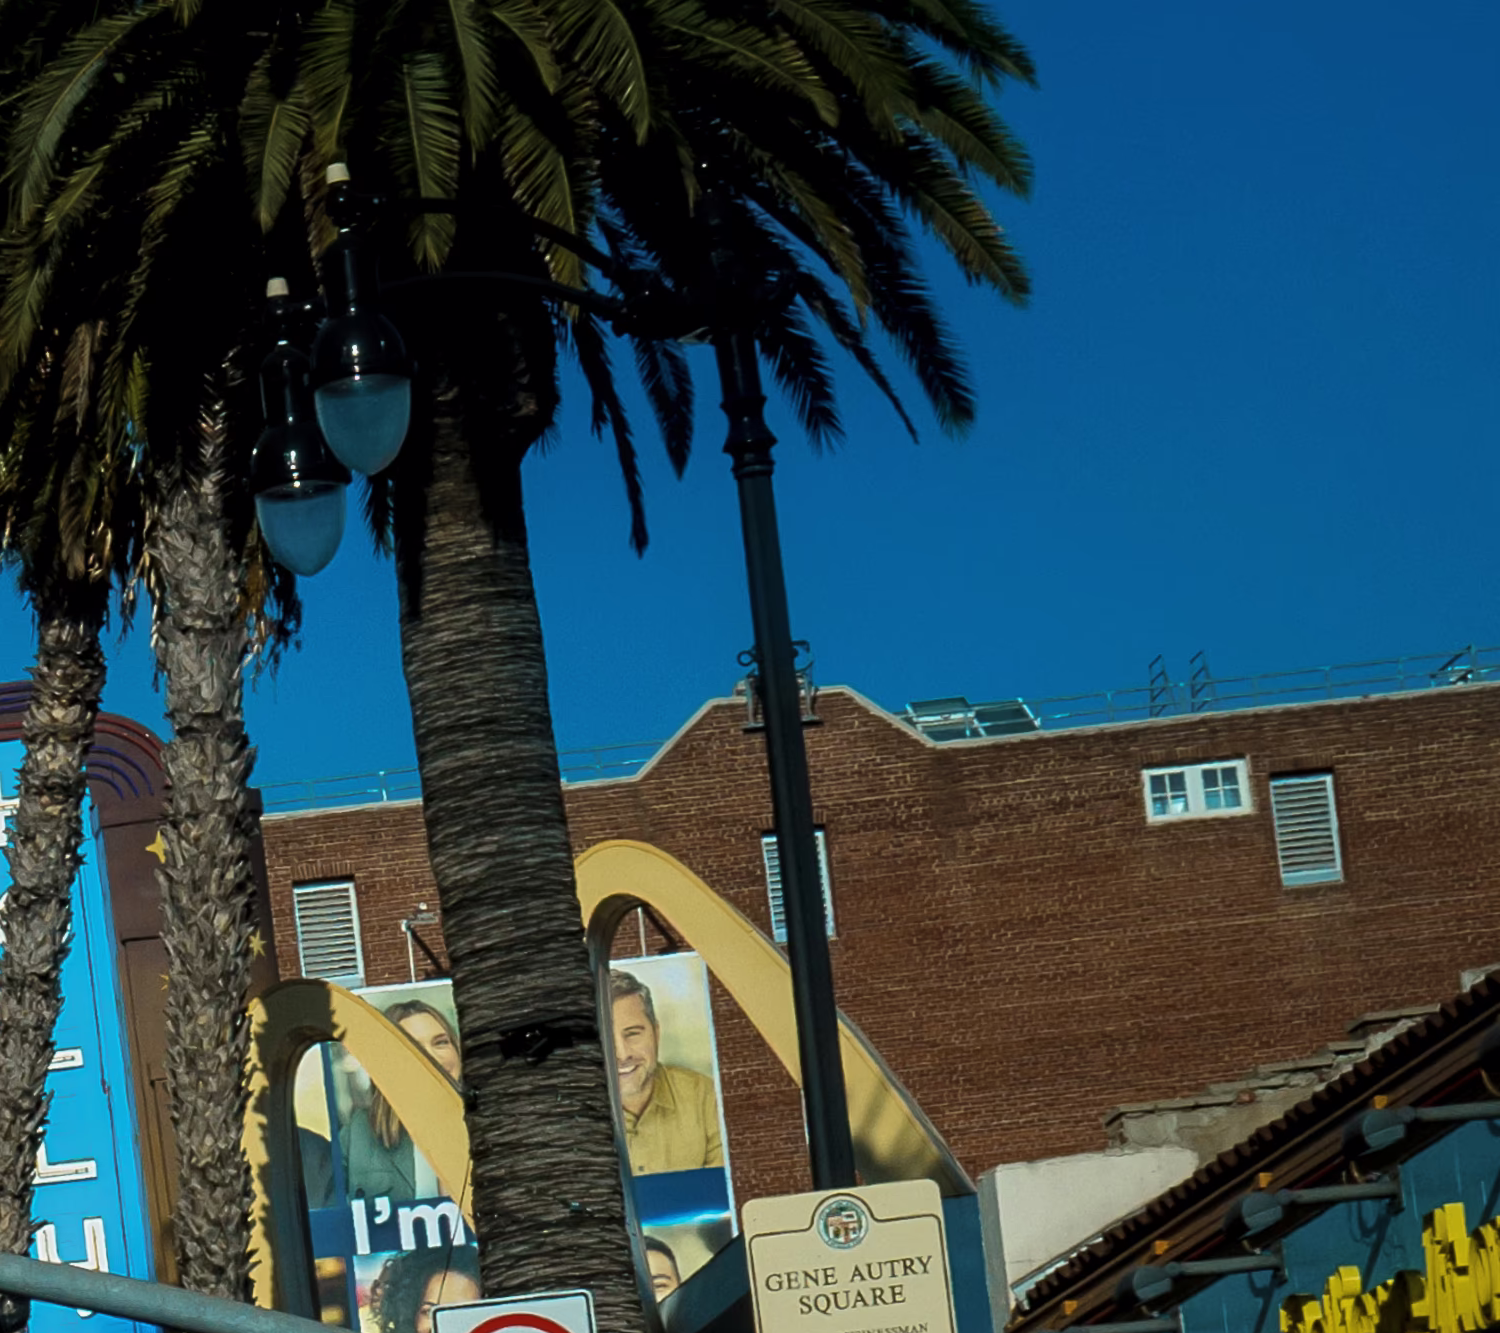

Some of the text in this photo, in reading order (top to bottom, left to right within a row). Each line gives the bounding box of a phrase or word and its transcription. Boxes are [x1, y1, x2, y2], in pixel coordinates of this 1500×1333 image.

[765, 1255, 932, 1292] GENE AUTRY
[799, 1284, 906, 1316] SQUARE
